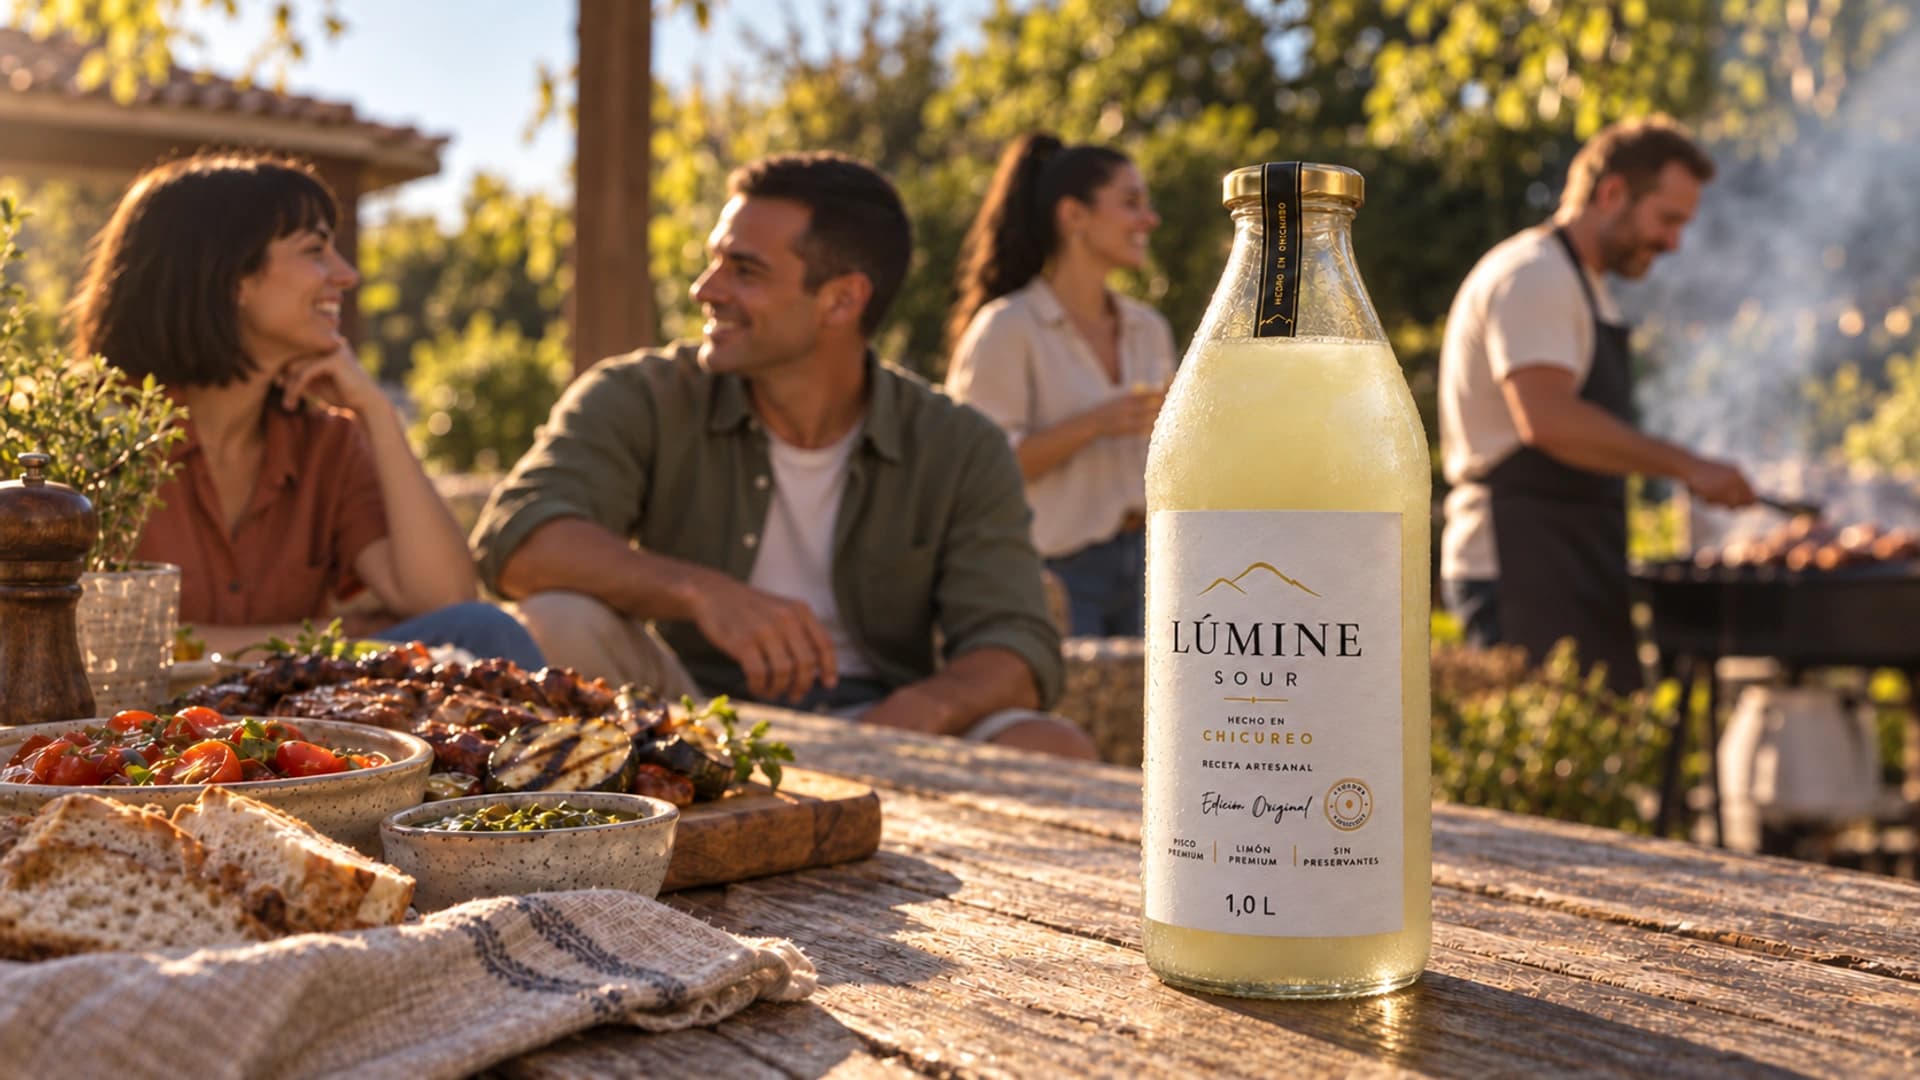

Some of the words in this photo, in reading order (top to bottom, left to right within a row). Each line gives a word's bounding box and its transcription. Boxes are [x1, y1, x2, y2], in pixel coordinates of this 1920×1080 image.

[1171, 613, 1363, 658] LÚMINE
[1214, 670, 1298, 687] SOUR
[1227, 715, 1265, 725] HECHO
[1270, 716, 1285, 726] EN
[1202, 729, 1313, 745] CHICUREO
[1202, 759, 1241, 770] RECETA
[1245, 762, 1313, 772] ARTESANAL
[1252, 795, 1313, 824] Original
[1173, 838, 1197, 848] PISCO
[1236, 844, 1271, 854] LIMÓN
[1168, 848, 1204, 861] PREMIUM
[1333, 847, 1352, 856] SIN
[1228, 856, 1277, 866] PREMIUM
[1303, 856, 1380, 867] PRESERVANTES
[1225, 894, 1256, 918] 1,0
[1263, 896, 1277, 916] L
